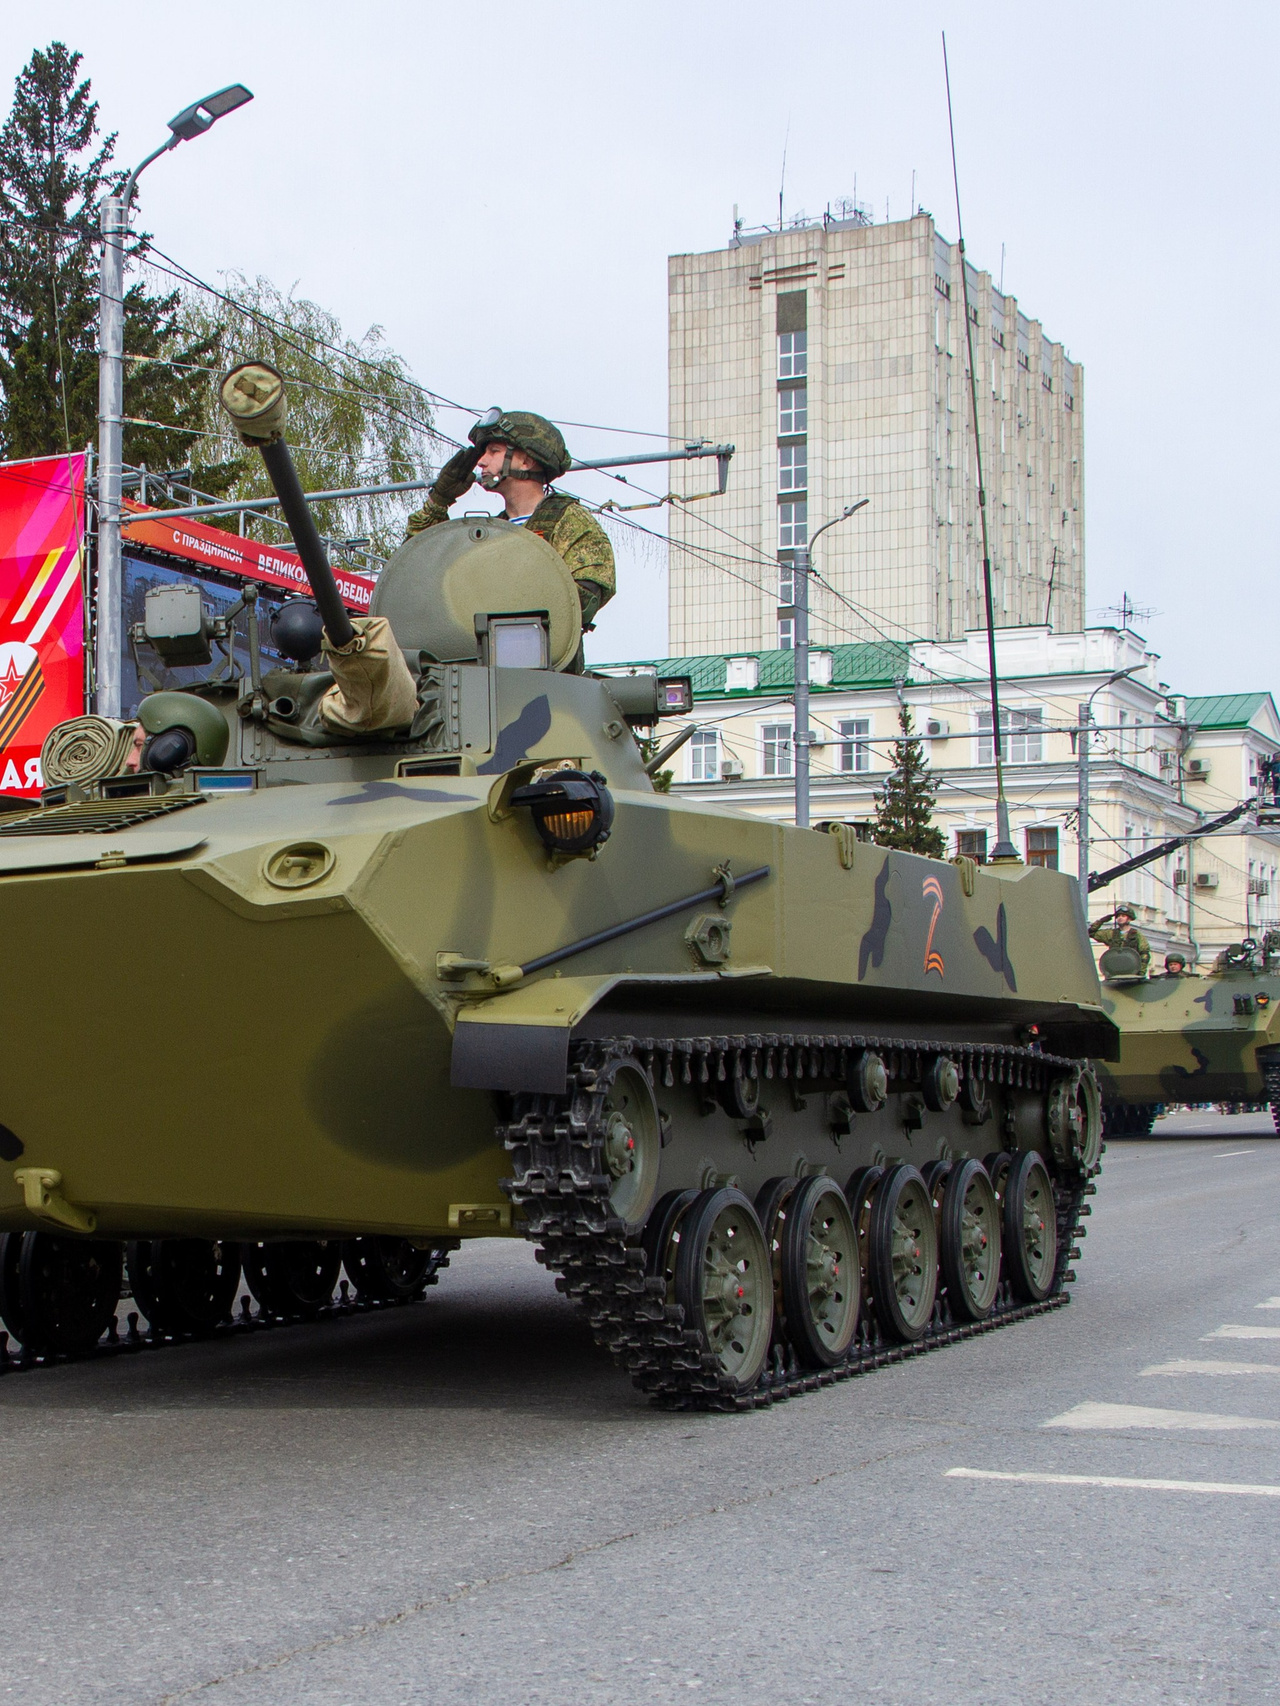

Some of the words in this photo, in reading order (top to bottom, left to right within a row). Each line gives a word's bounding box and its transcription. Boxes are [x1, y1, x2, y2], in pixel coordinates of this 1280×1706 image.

[172, 530, 181, 544] С
[182, 533, 244, 564] ПРАЗДНИКОМ
[333, 577, 374, 605] ОБЕДЫ
